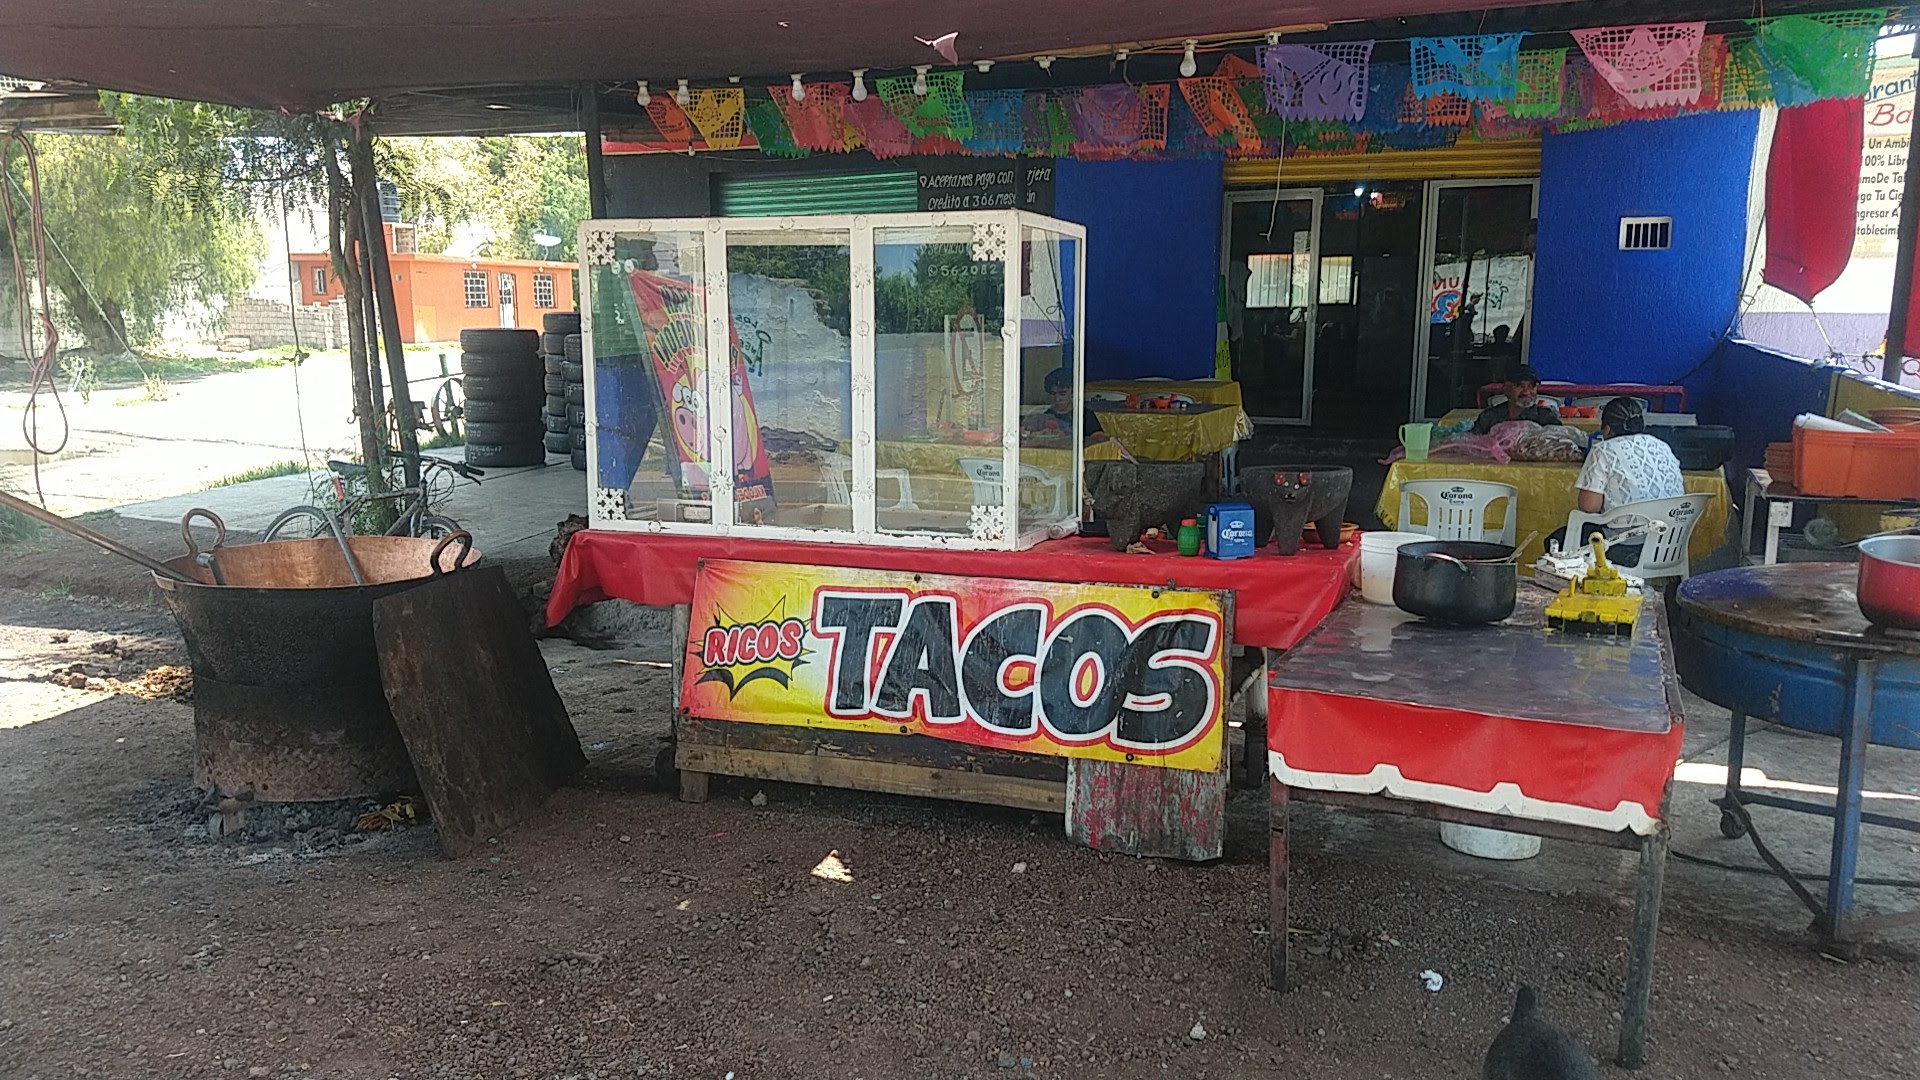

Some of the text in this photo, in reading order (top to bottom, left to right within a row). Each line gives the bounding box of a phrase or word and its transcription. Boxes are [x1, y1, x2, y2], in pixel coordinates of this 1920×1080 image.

[1869, 138, 1881, 149] Un
[1863, 154, 1885, 167] 00%
[1026, 166, 1052, 186] rjeta
[1859, 193, 1872, 204] ga
[1875, 190, 1886, 201] Tu
[1440, 490, 1473, 500] Corona
[1221, 528, 1253, 540] Corona
[703, 618, 805, 667] RICOS
[816, 589, 1218, 748] TACOS
